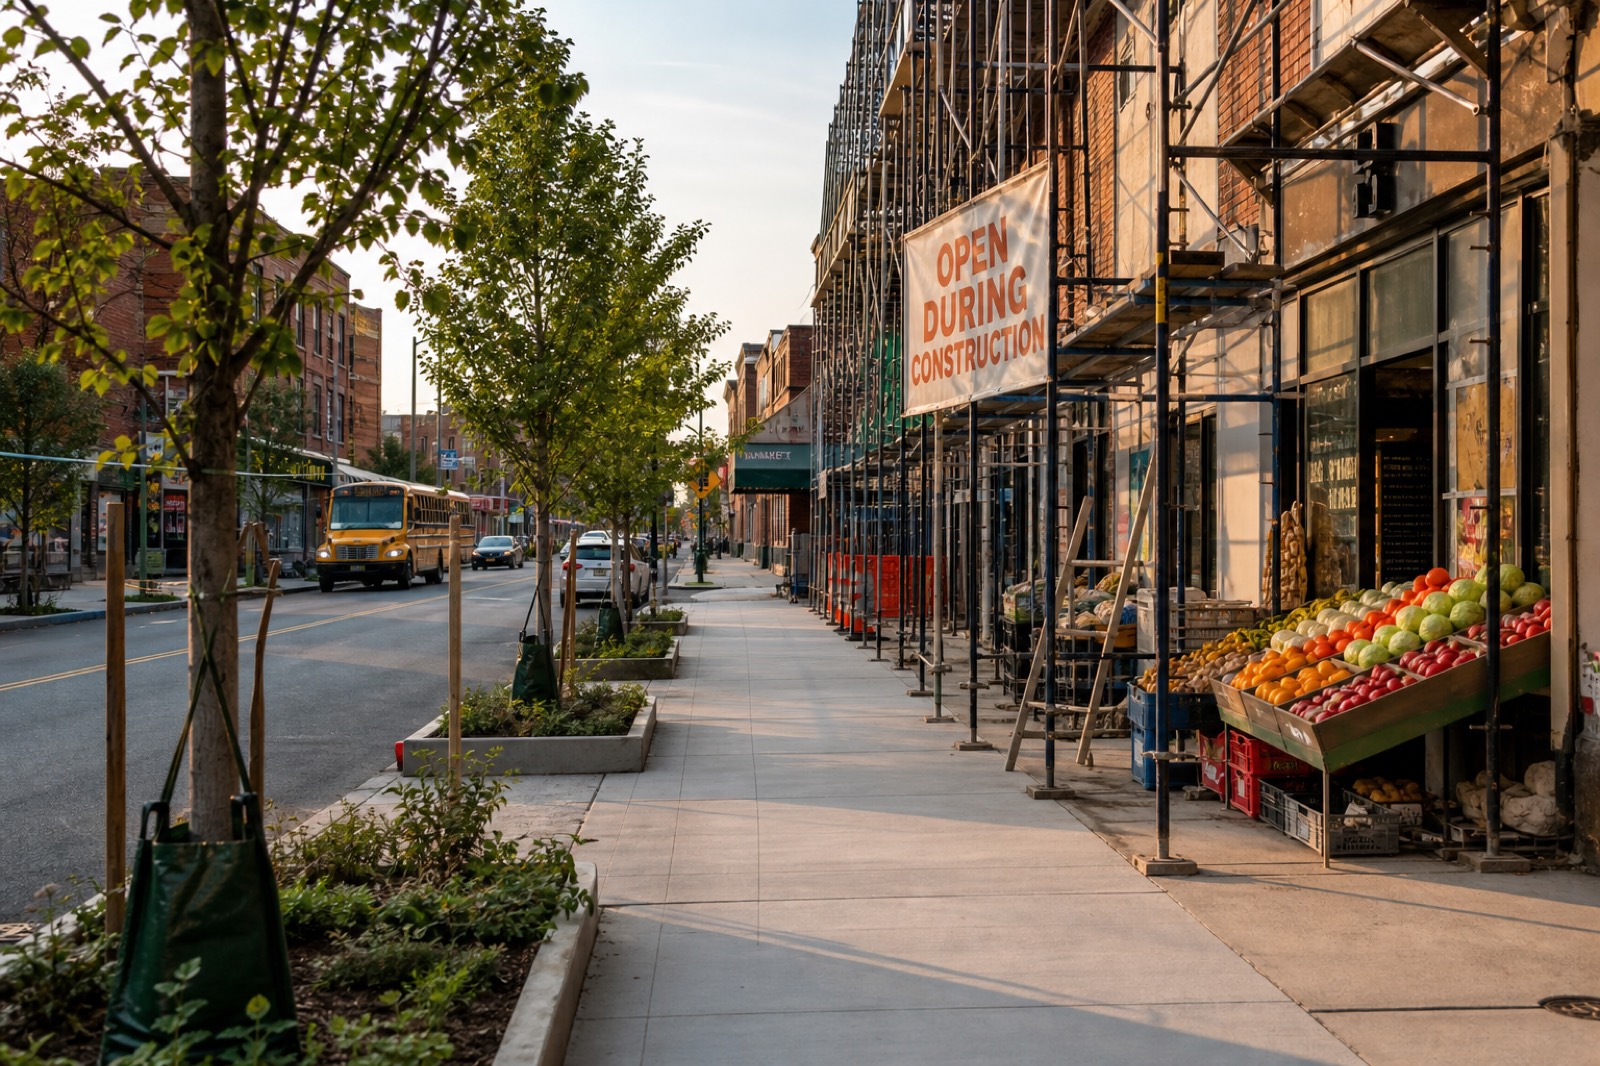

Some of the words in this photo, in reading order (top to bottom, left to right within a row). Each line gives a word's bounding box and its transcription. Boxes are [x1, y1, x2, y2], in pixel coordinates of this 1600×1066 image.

[937, 216, 1008, 288] OPEN
[923, 265, 1027, 343] DURING
[911, 314, 1045, 387] CONSTRUCTION
